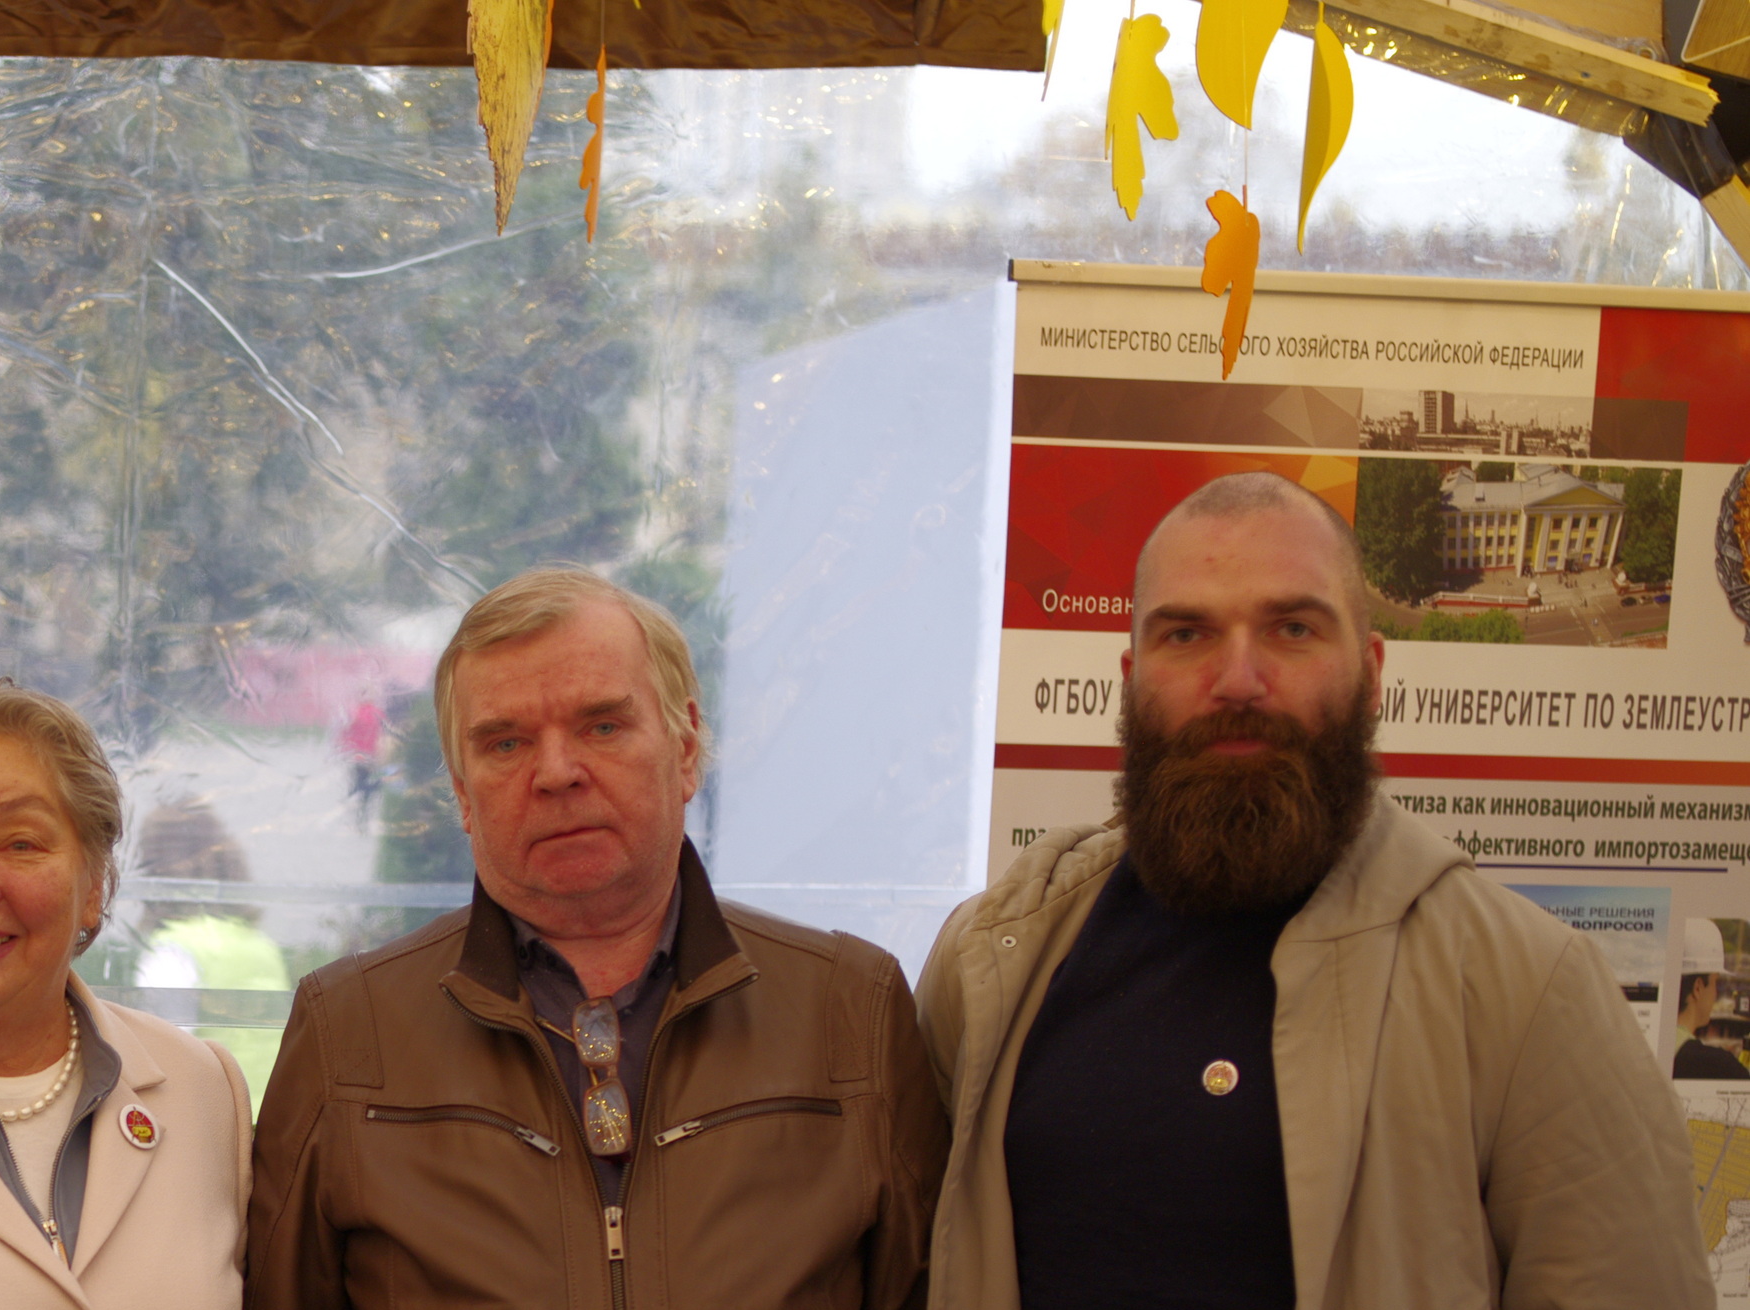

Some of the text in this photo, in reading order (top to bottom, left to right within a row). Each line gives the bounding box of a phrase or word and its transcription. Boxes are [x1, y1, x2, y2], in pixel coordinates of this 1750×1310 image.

[1040, 327, 1584, 372] МИНИСТЕРСТВО СЕЛЬОГО ХОЗЯЙСТВА РОССИЙСКОЙ ФЕДЕРАЦИИ
[1035, 677, 1113, 717] ФГБОУ
[1415, 687, 1576, 728] УНИВЕРСИТЕТ
[1584, 692, 1615, 729] ПО
[1452, 795, 1486, 815] как
[1491, 794, 1656, 822] инновационный
[1447, 830, 1585, 861] ффективного
[1571, 919, 1653, 932] ВОПРОСОВ
[1590, 907, 1655, 919] РЕШЕНИЯ
